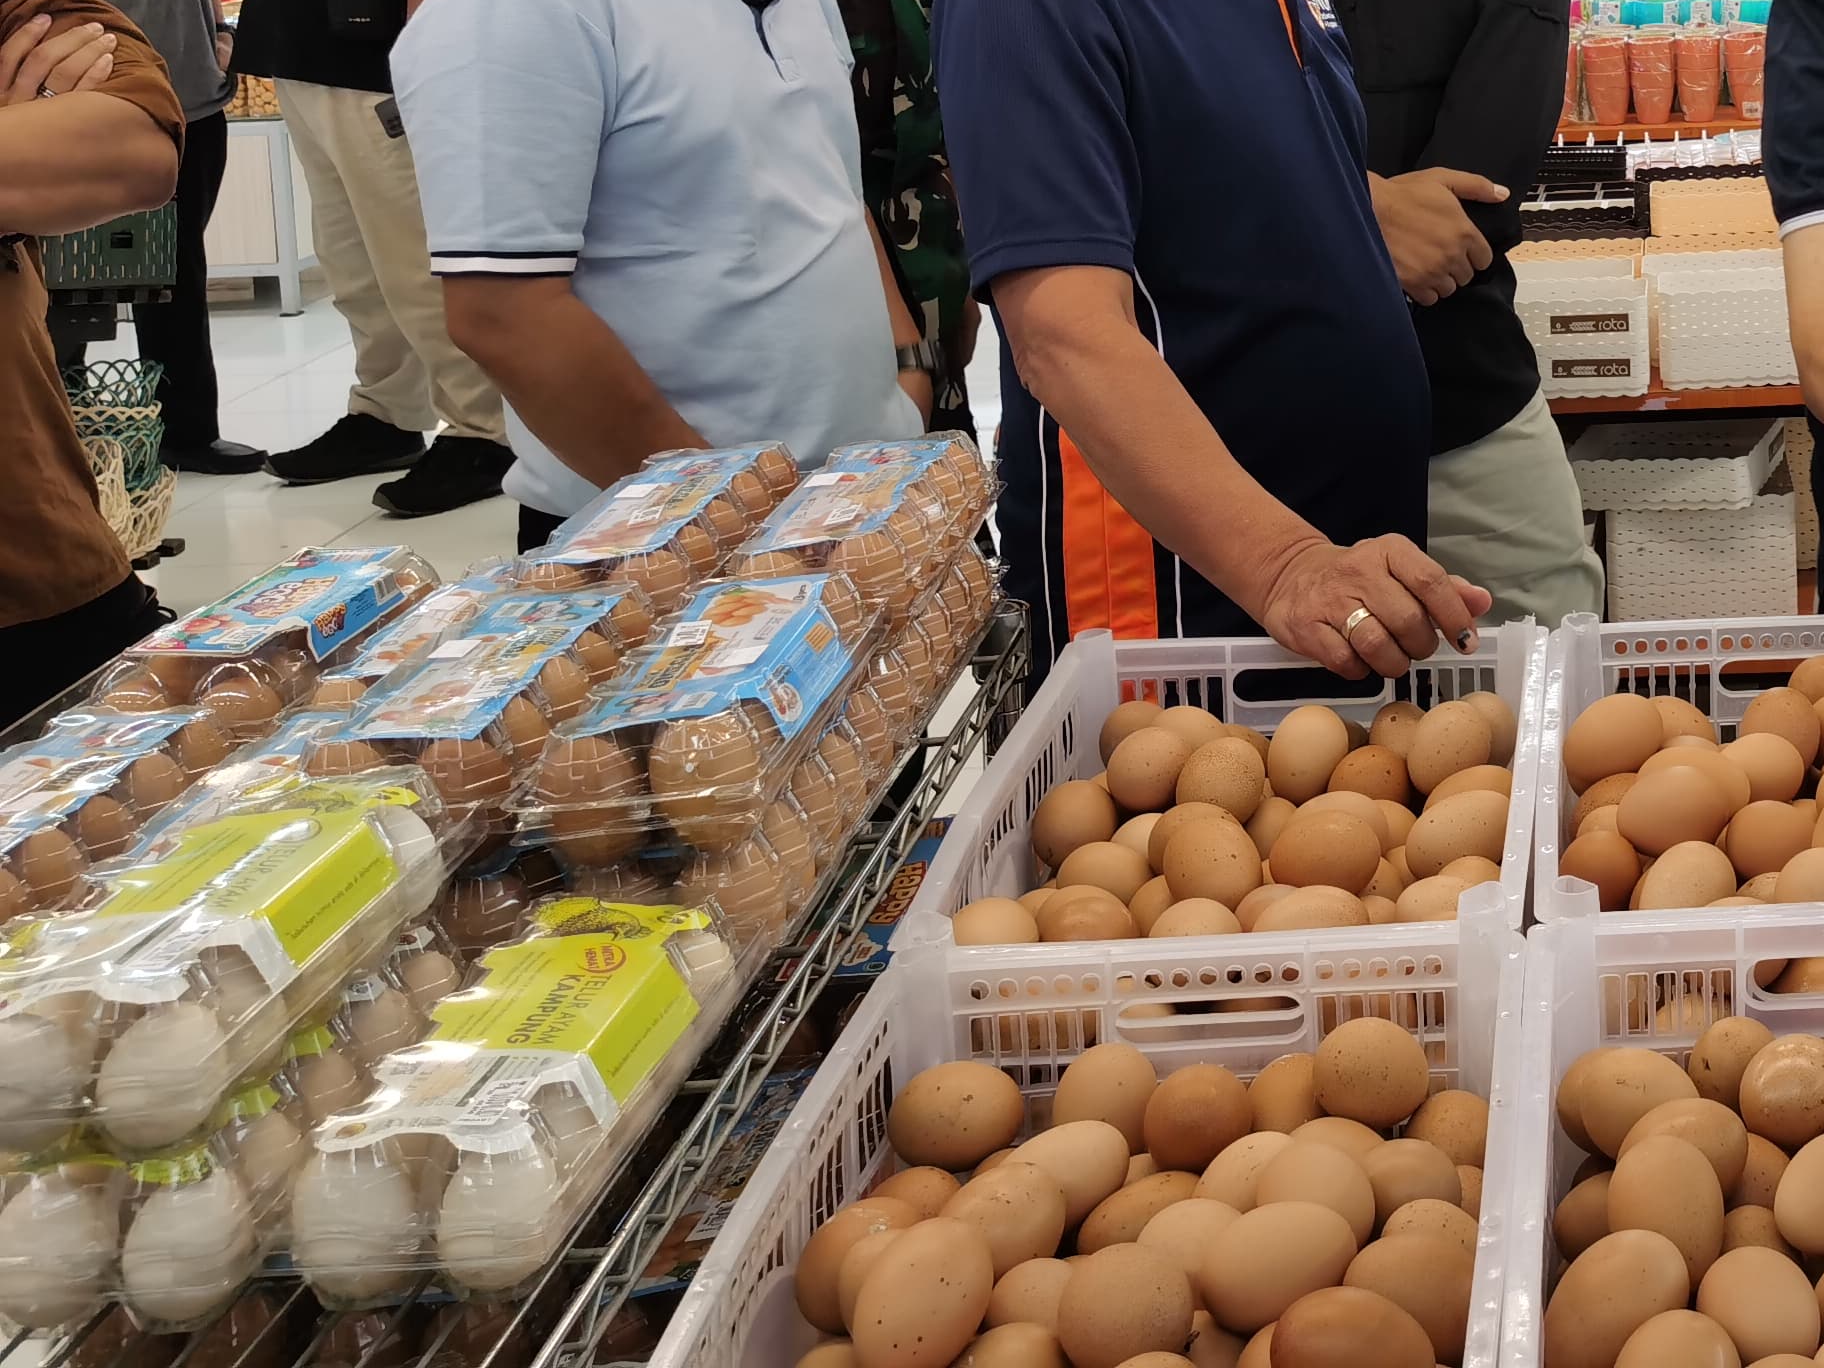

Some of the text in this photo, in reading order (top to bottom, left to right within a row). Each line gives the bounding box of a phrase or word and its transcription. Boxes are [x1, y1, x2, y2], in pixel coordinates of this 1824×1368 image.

[1599, 318, 1627, 331] rota
[1600, 362, 1629, 375] rota
[506, 974, 585, 1044] KAMPUNG
[533, 974, 613, 1045] TELUR AYAM
